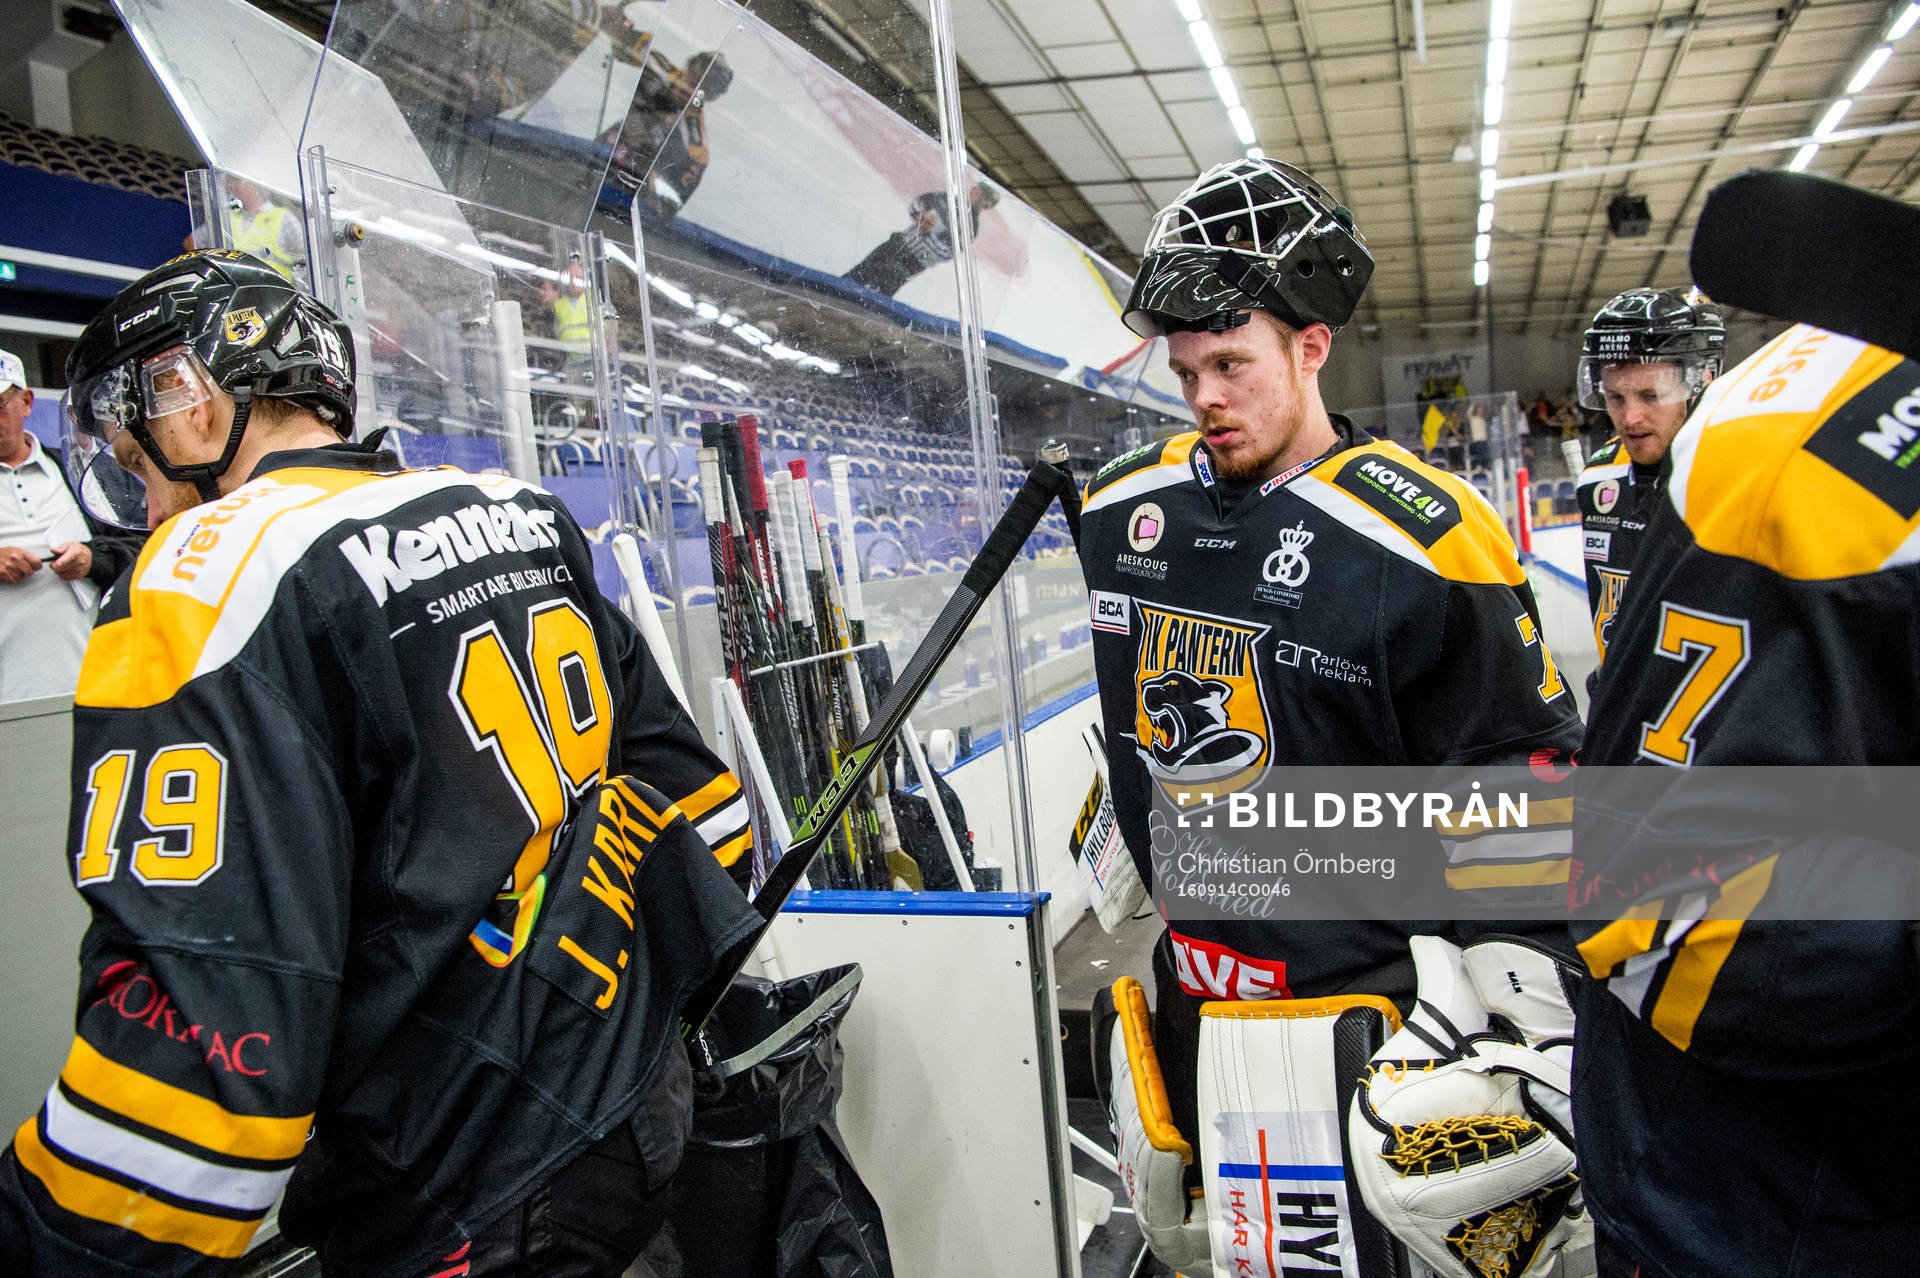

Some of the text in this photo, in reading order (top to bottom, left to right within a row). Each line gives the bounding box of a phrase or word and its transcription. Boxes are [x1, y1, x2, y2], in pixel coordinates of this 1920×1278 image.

[118, 305, 161, 332] CCM
[311, 320, 345, 370] 19
[1598, 344, 1630, 352] ARENA
[1598, 351, 1630, 361] HOTEL
[1855, 385, 1920, 462] MO
[1359, 460, 1447, 519] MOVE4U
[1193, 538, 1238, 550] CCM
[1621, 520, 1647, 531] CCM
[1116, 553, 1169, 571] ARESKOUG
[1098, 600, 1123, 618] BCA
[1144, 611, 1253, 678] IK PANTERN
[1320, 654, 1369, 675] arlövs
[1515, 611, 1567, 705] 7
[1318, 666, 1373, 688] reklam
[1639, 600, 1752, 771] 7
[75, 742, 230, 889] 19
[808, 755, 860, 832] CCM
[557, 935, 630, 1011] J.
[1228, 1190, 1249, 1248] HAR
